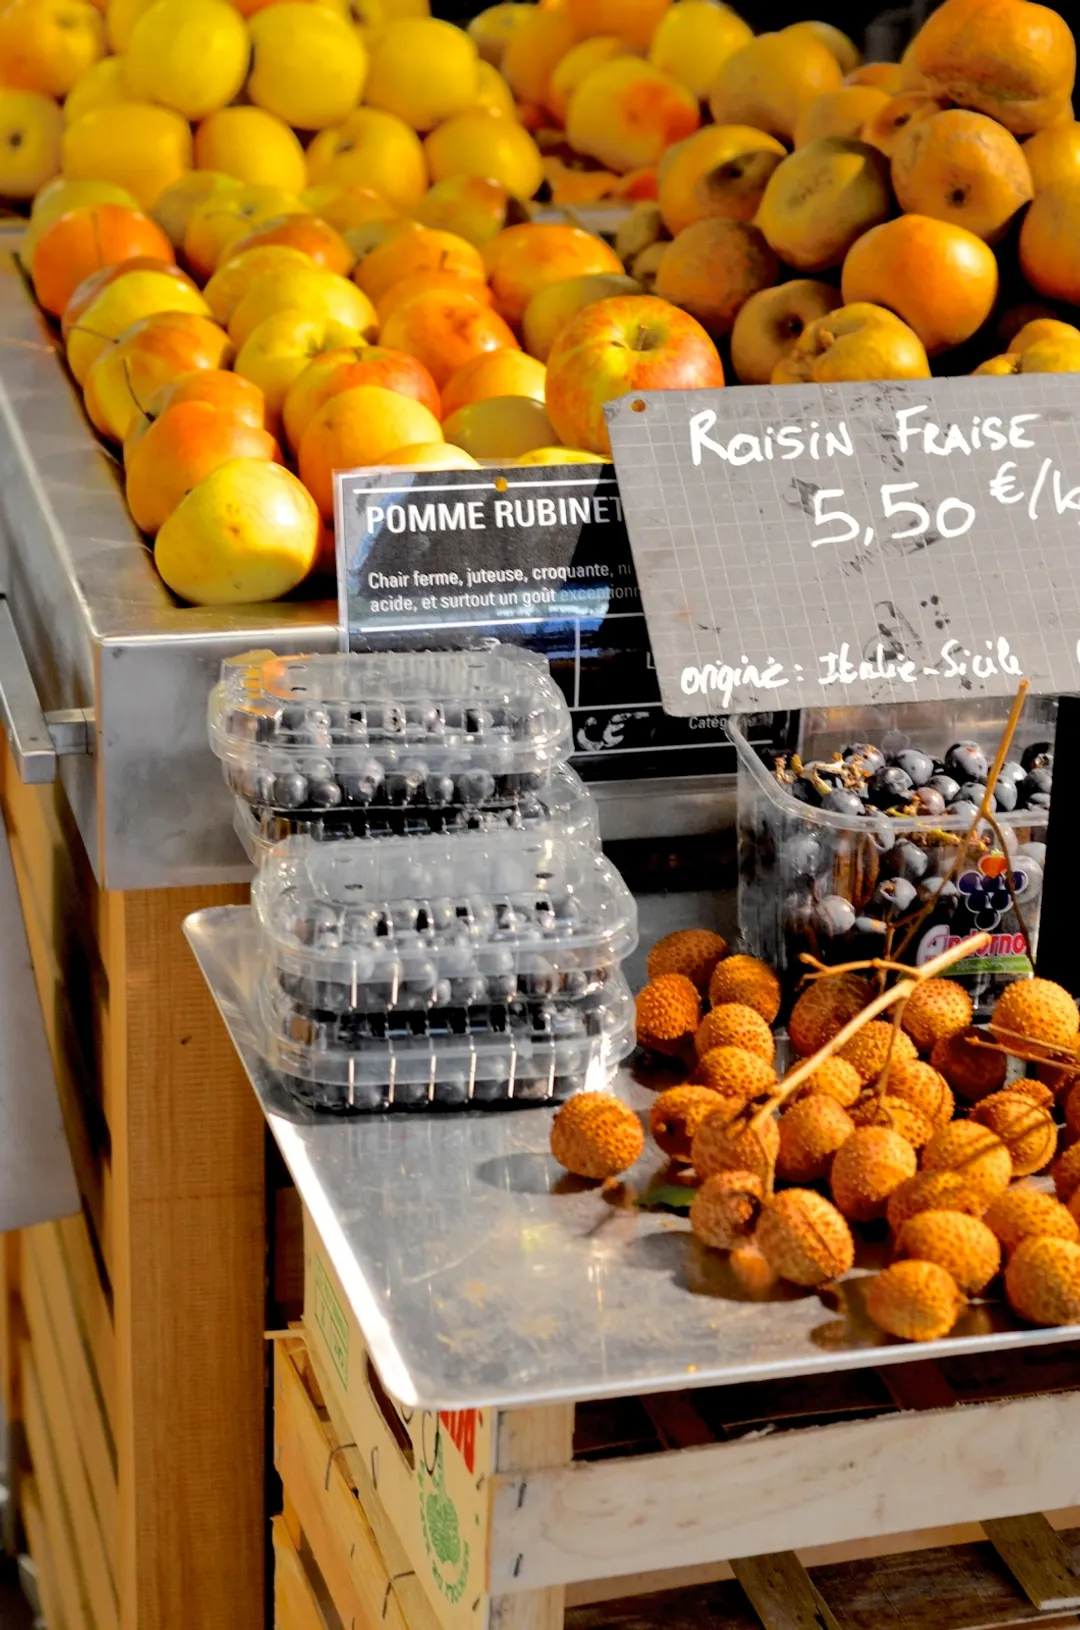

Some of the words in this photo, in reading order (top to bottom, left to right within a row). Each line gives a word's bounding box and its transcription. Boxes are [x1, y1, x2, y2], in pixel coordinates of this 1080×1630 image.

[366, 502, 486, 534] POMME
[811, 482, 977, 548] 5,50
[368, 570, 410, 590] Chair
[413, 569, 464, 589] ferme,
[467, 565, 529, 588] juteuse,
[532, 563, 614, 584] croquante,
[370, 592, 418, 614] acide,
[422, 592, 438, 610] et
[441, 588, 497, 609] surtout
[499, 587, 519, 607] un
[523, 582, 557, 608] goût
